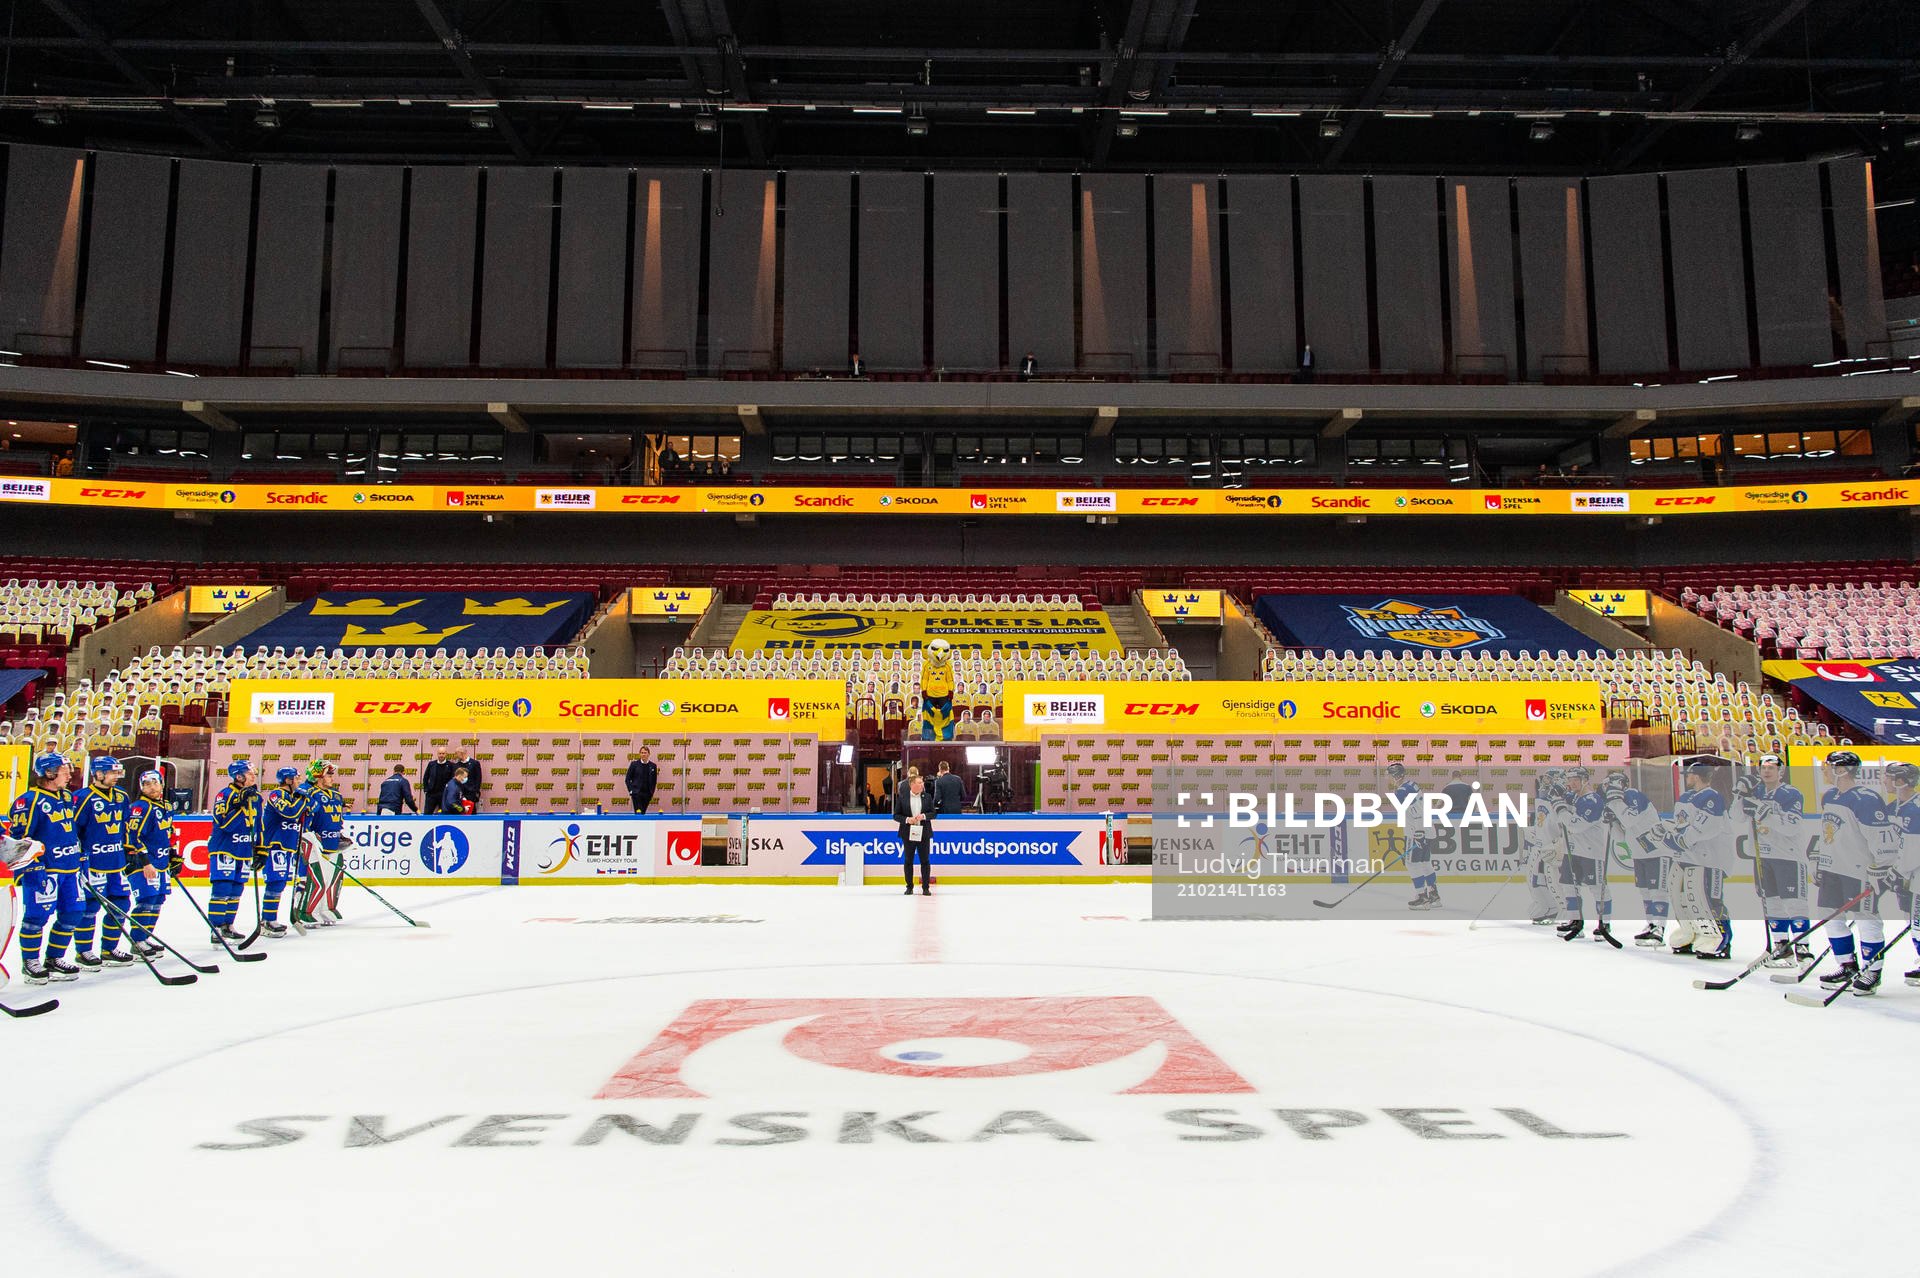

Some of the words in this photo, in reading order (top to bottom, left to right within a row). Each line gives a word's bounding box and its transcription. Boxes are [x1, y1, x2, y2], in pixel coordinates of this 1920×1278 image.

[2, 483, 44, 493] BEIJER
[79, 487, 146, 499] CCM
[266, 490, 328, 505] Scandic
[369, 493, 414, 503] ŠKODA
[554, 494, 591, 502] BEIJER
[621, 495, 681, 505] CCM
[707, 493, 748, 502] Gjensidige
[794, 494, 855, 507] Scandic
[895, 496, 938, 505] ŠKODA
[1076, 496, 1111, 504] BEIJER
[1589, 497, 1624, 505] BEIJER
[1840, 488, 1909, 503] Scandic
[1141, 497, 1199, 507] CCM
[1311, 495, 1371, 509] Scandic
[1410, 496, 1453, 507] ŠKODA
[1654, 496, 1716, 507] CCM
[925, 617, 1042, 627] FOLKETS
[1049, 617, 1101, 627] LAG
[765, 639, 814, 649] Bli
[278, 700, 325, 711] BEIJER
[354, 702, 432, 713] CCM
[456, 698, 510, 710] Gjensidige
[559, 699, 639, 717] Scandic
[680, 701, 738, 713] ŠKODA
[793, 702, 840, 711] SVENSKA
[1050, 701, 1096, 712] BEIJER
[1124, 704, 1199, 715] CCM
[1222, 699, 1275, 711] Gjensidige
[1441, 703, 1497, 714] ŠKODA
[1550, 703, 1596, 711] SVENSKA
[793, 711, 817, 719] SPEL
[1323, 702, 1400, 718] Scandic
[1550, 712, 1574, 720] SPEL
[215, 803, 225, 814] 26
[276, 799, 287, 811] 23
[506, 826, 516, 870] CCM
[586, 835, 638, 856] EHT
[751, 838, 784, 850] SKA
[930, 838, 1058, 858] huvudsponsor
[1275, 834, 1326, 855] EHT
[197, 1109, 1093, 1150] SVENSKA
[1163, 1107, 1632, 1143] SPEL
